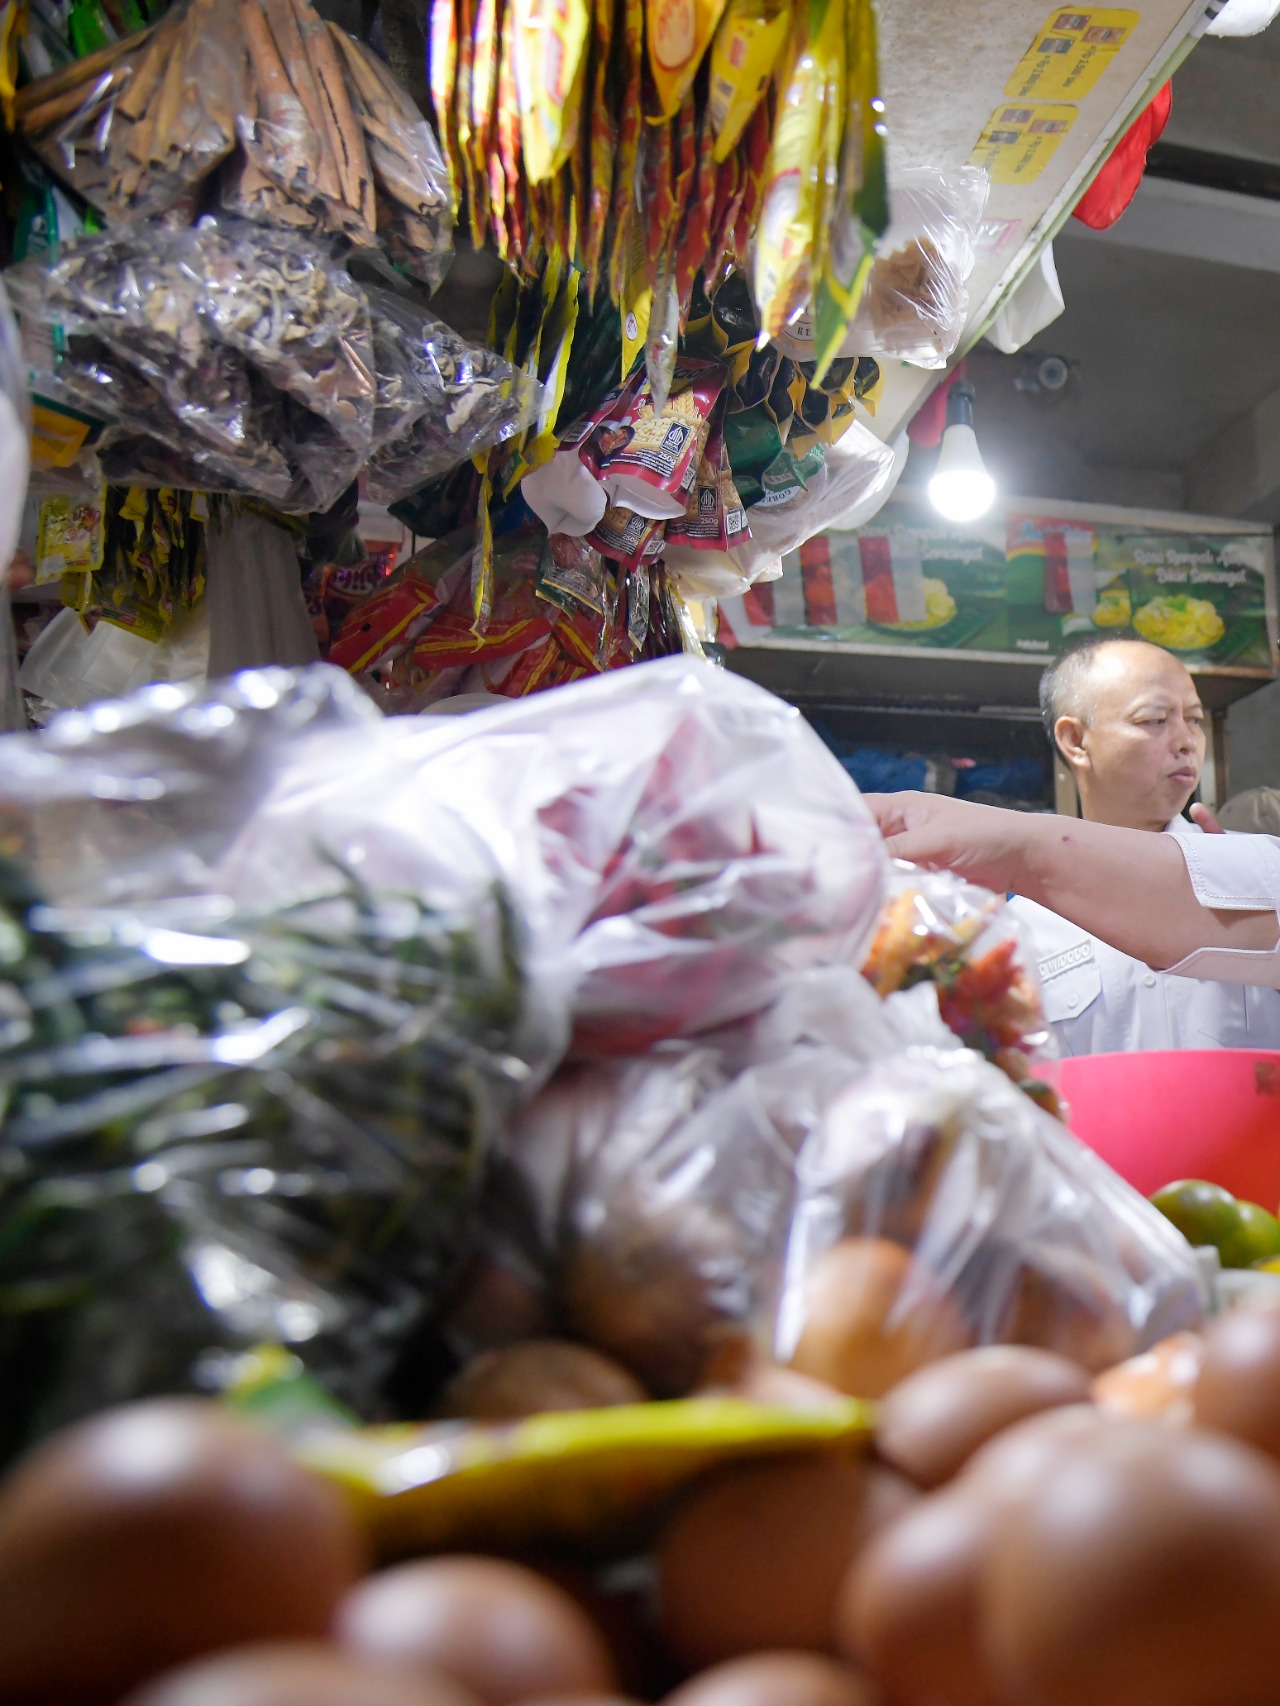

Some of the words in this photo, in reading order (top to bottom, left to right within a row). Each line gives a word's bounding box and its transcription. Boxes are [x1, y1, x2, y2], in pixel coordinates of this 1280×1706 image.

[658, 451, 677, 466] 250g
[701, 517, 719, 526] 250g
[622, 533, 639, 546] 250g
[1047, 944, 1090, 974] WIDODO
